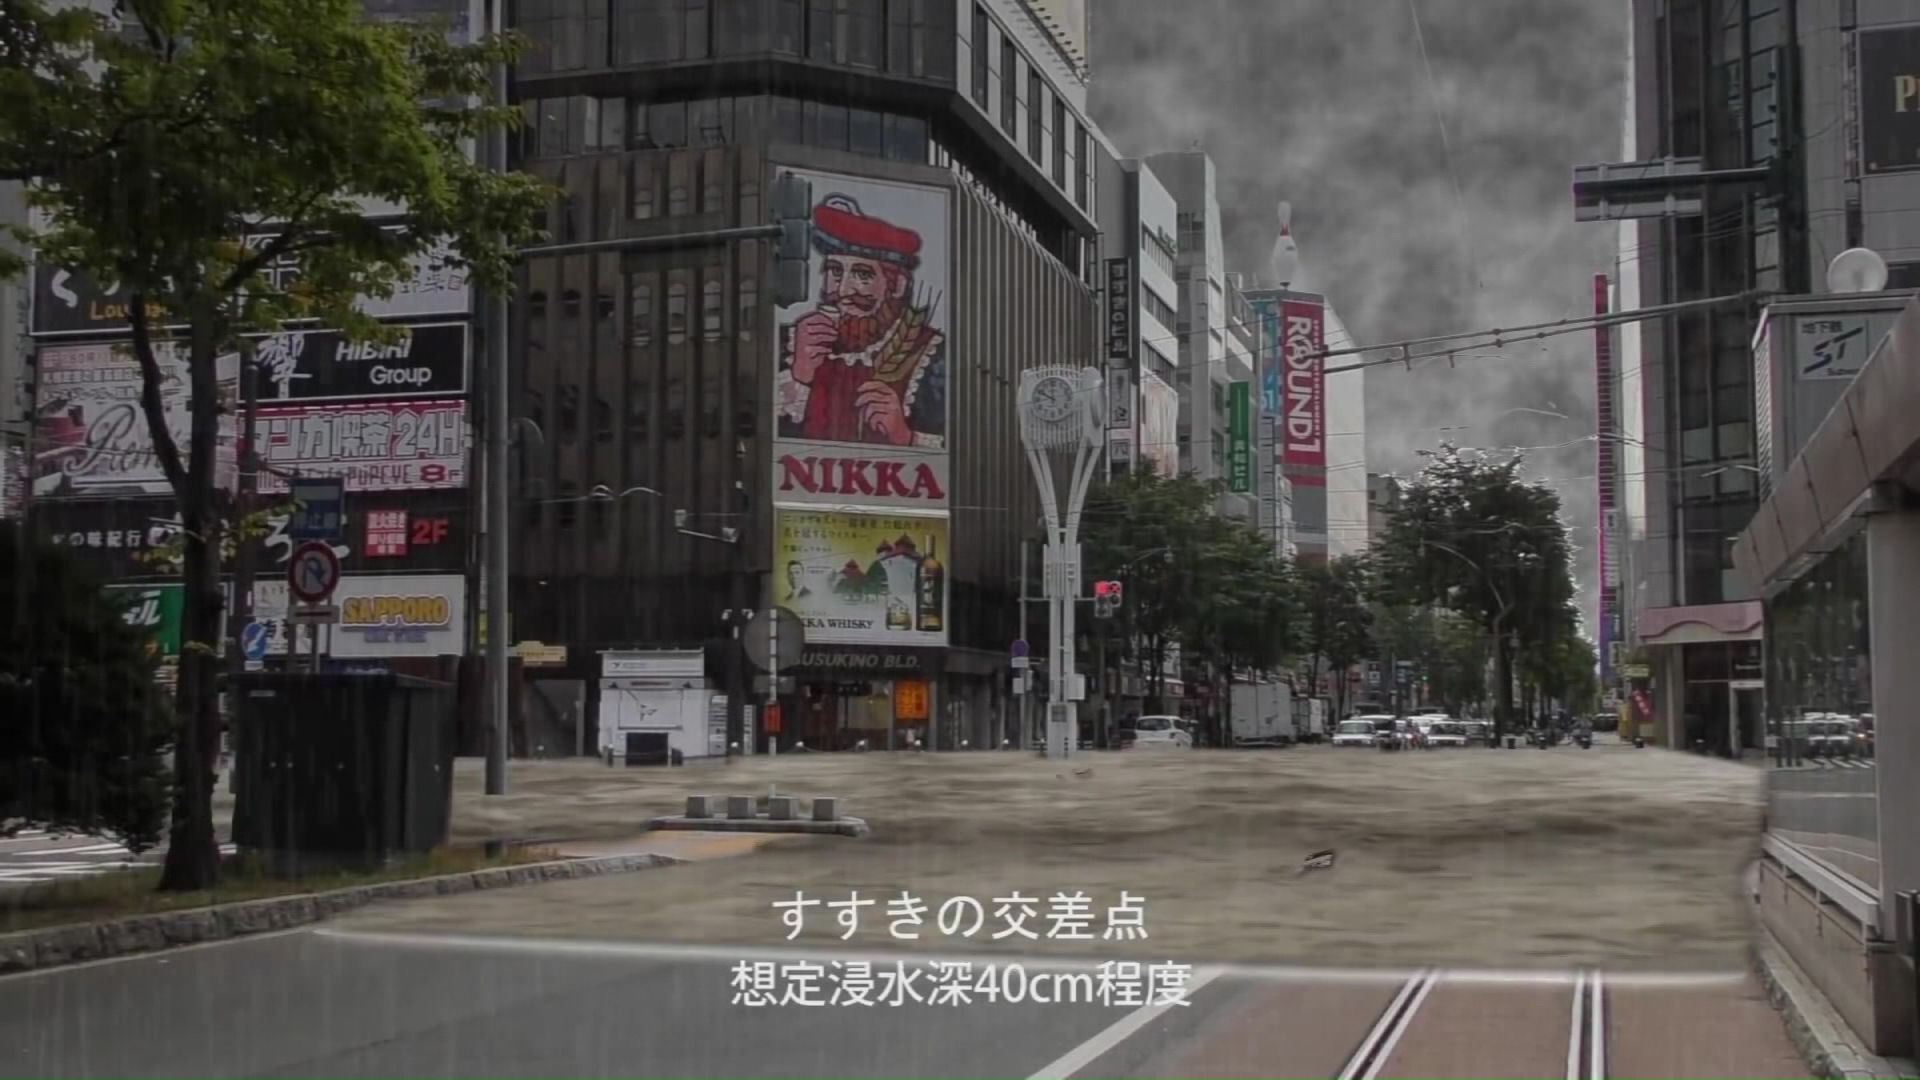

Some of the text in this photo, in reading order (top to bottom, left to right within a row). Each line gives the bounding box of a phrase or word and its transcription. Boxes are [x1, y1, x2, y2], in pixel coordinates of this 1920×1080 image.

[369, 365, 432, 387] Group
[345, 465, 413, 485] POPEYE
[778, 454, 945, 500] NIKKA
[412, 518, 449, 545] 2F
[342, 595, 449, 626] SAPPORO
[800, 617, 874, 630] KKA WHISKY
[801, 653, 921, 669] USUKINO BLD.
